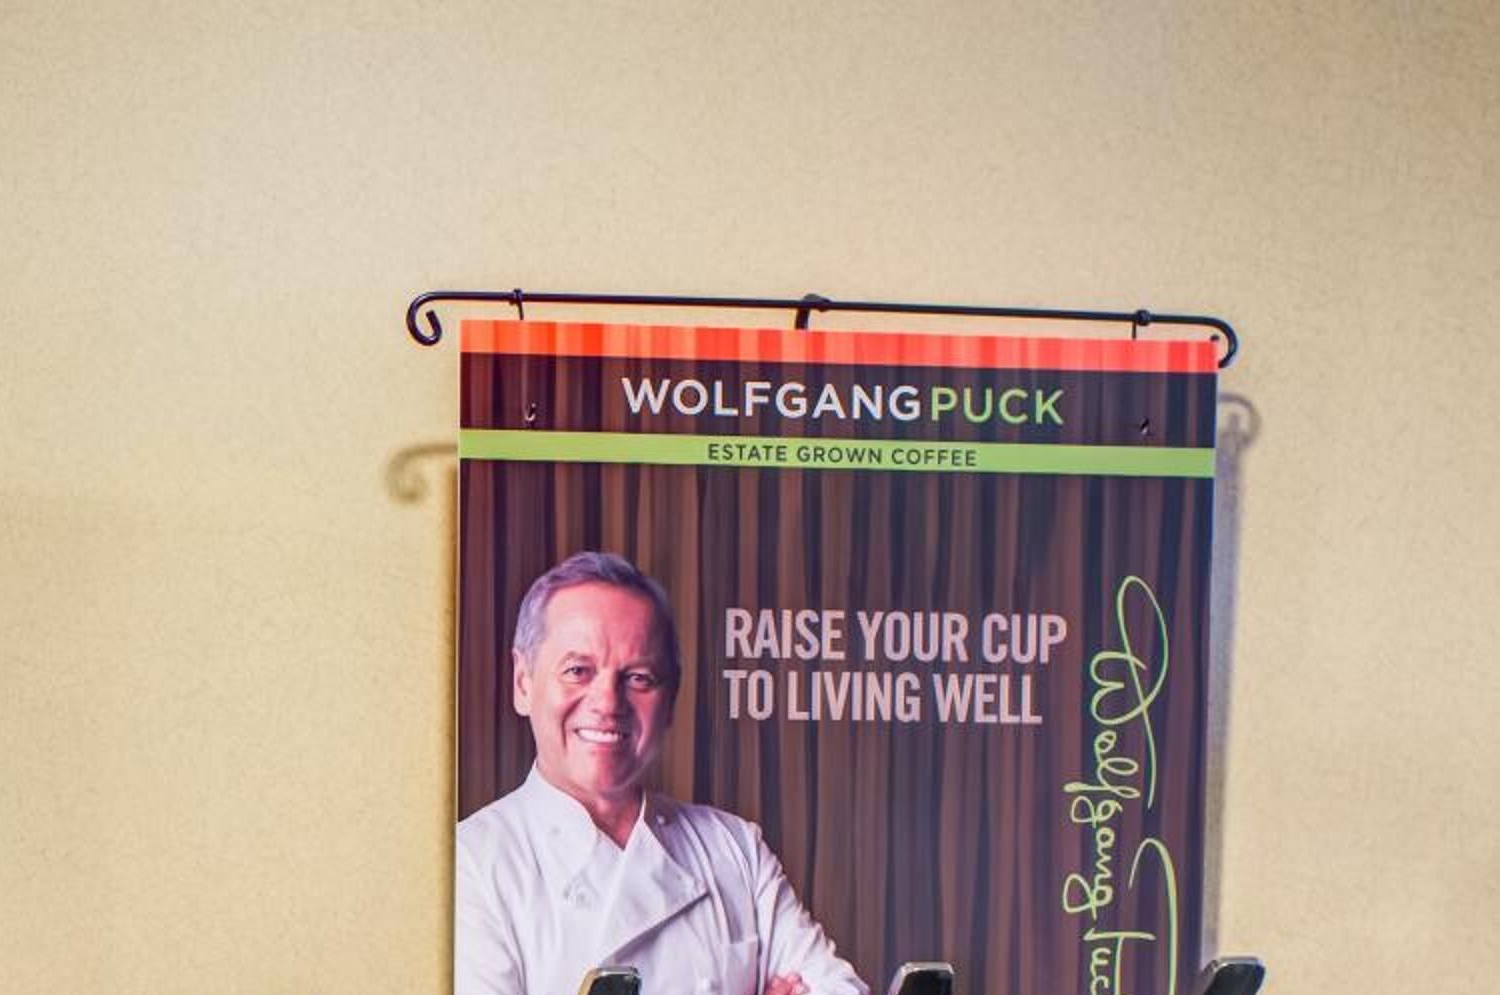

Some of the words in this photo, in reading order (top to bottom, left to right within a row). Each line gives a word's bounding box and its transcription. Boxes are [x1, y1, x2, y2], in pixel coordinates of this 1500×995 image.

[706, 442, 789, 462] ESTATE
[796, 446, 883, 464] GROWN
[890, 449, 978, 467] COFFEE
[724, 607, 846, 660] RAISE
[856, 610, 970, 662] YOUR
[981, 613, 1068, 665] CUP
[723, 669, 775, 721] TO
[787, 670, 922, 722] LIVING
[932, 673, 1043, 724] WELL
